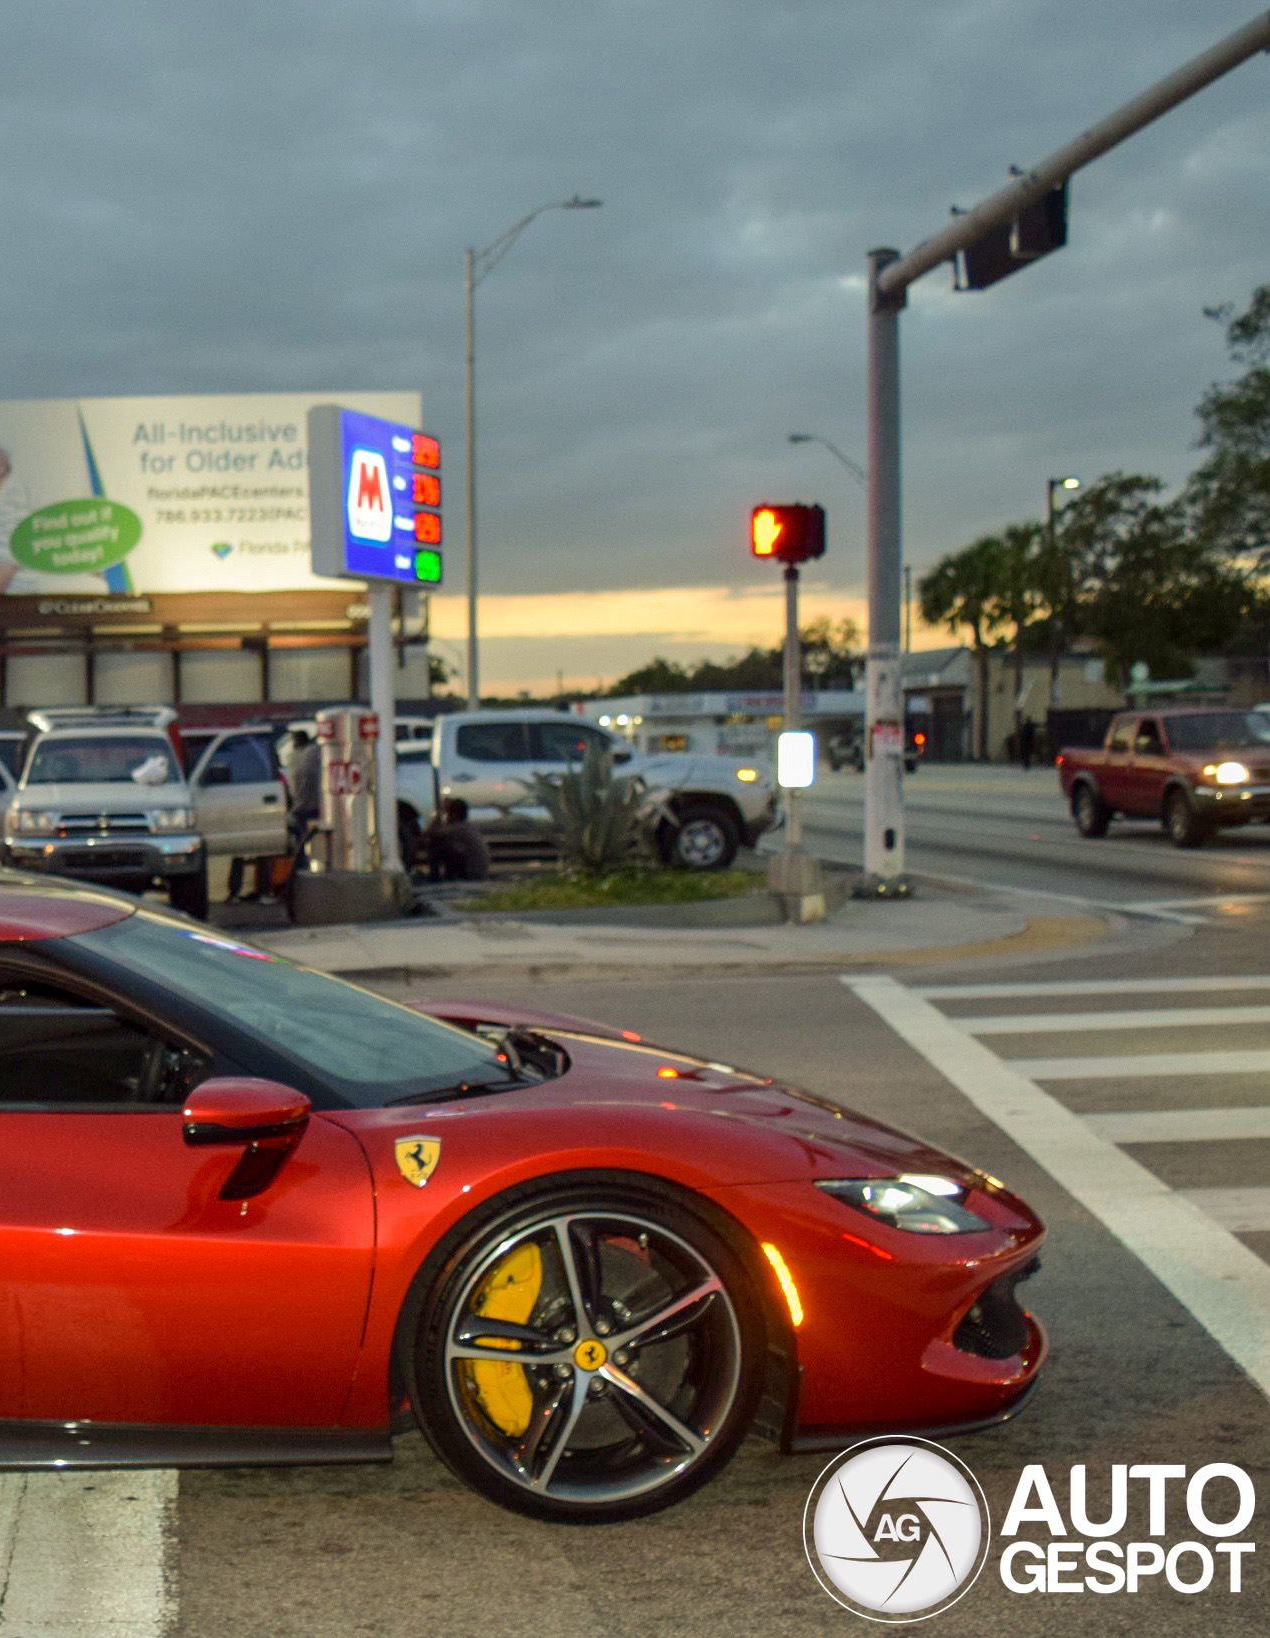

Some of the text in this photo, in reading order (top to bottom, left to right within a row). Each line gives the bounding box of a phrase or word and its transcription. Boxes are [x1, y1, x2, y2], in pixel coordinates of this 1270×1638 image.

[133, 417, 297, 445] All-Inclusive
[140, 451, 175, 474] for
[186, 449, 257, 473] Older
